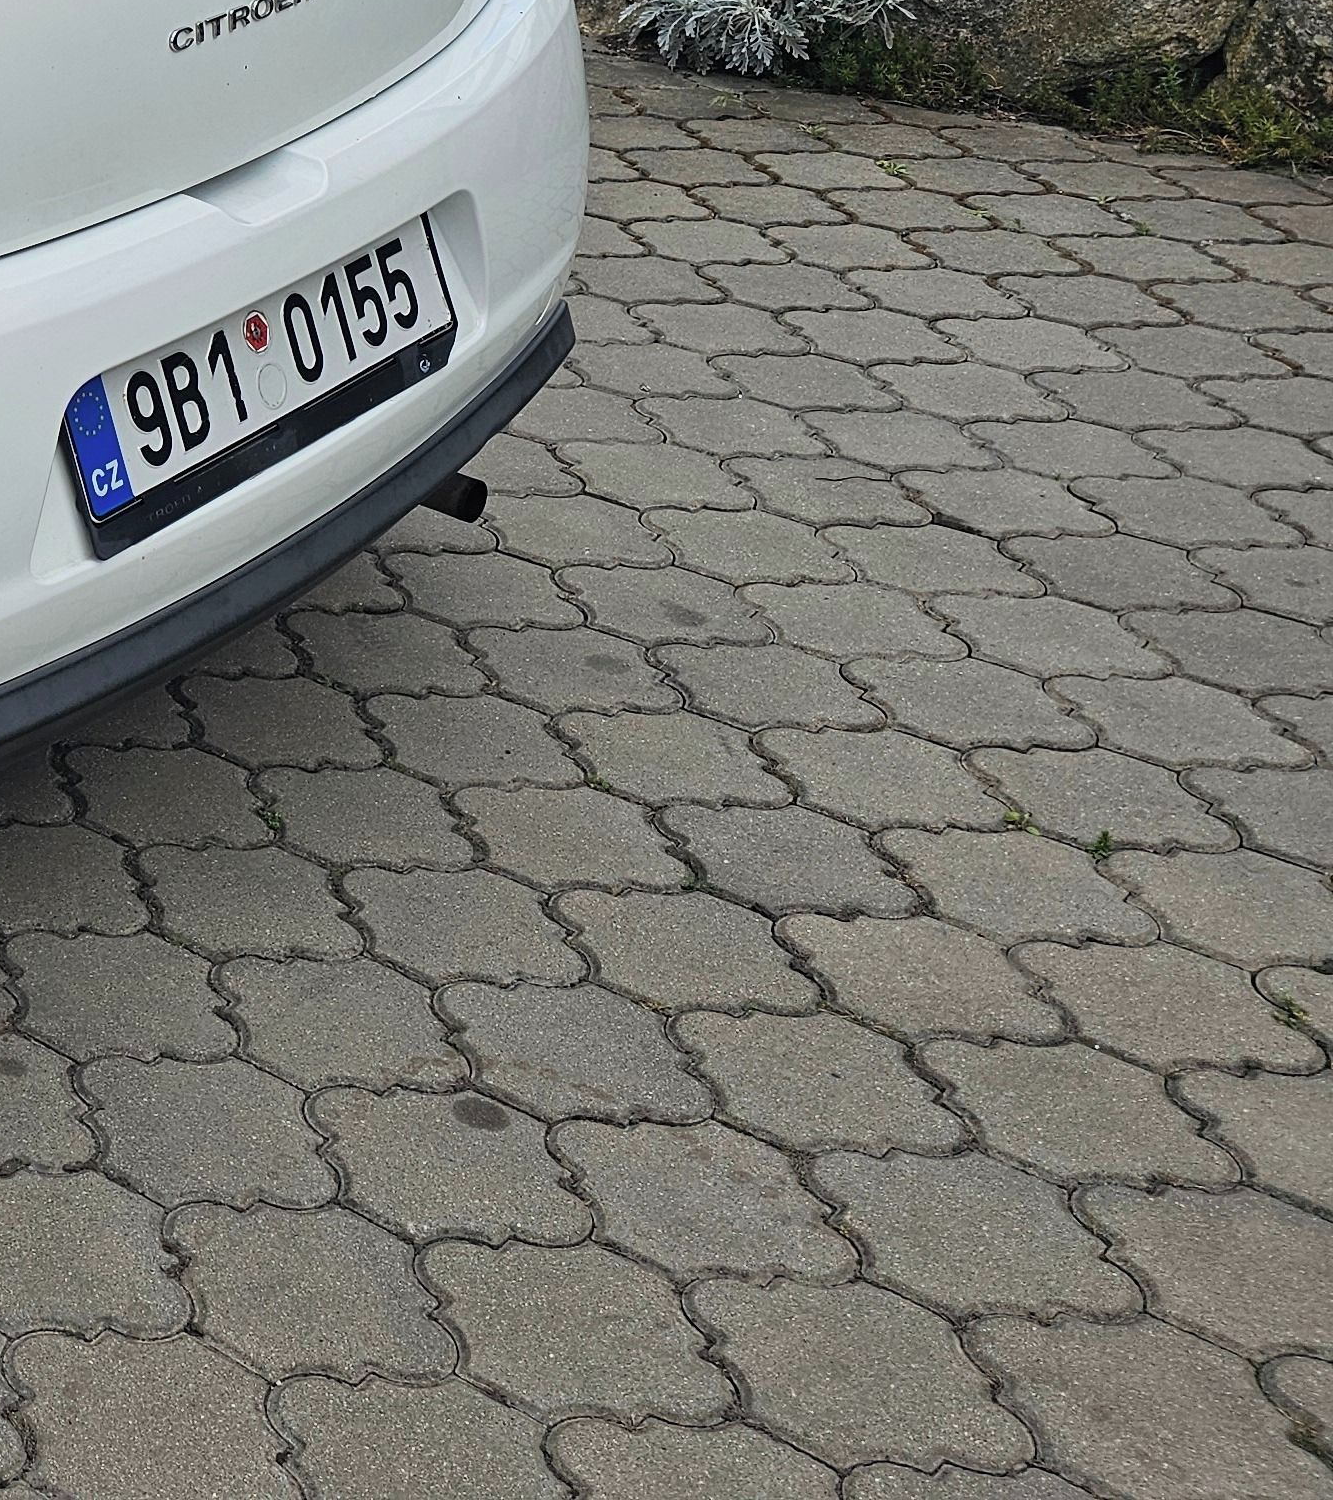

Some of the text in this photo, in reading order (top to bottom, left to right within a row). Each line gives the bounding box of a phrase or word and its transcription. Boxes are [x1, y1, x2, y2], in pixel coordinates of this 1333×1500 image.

[127, 237, 419, 467] 9B1 0155
[91, 458, 124, 497] CZ
